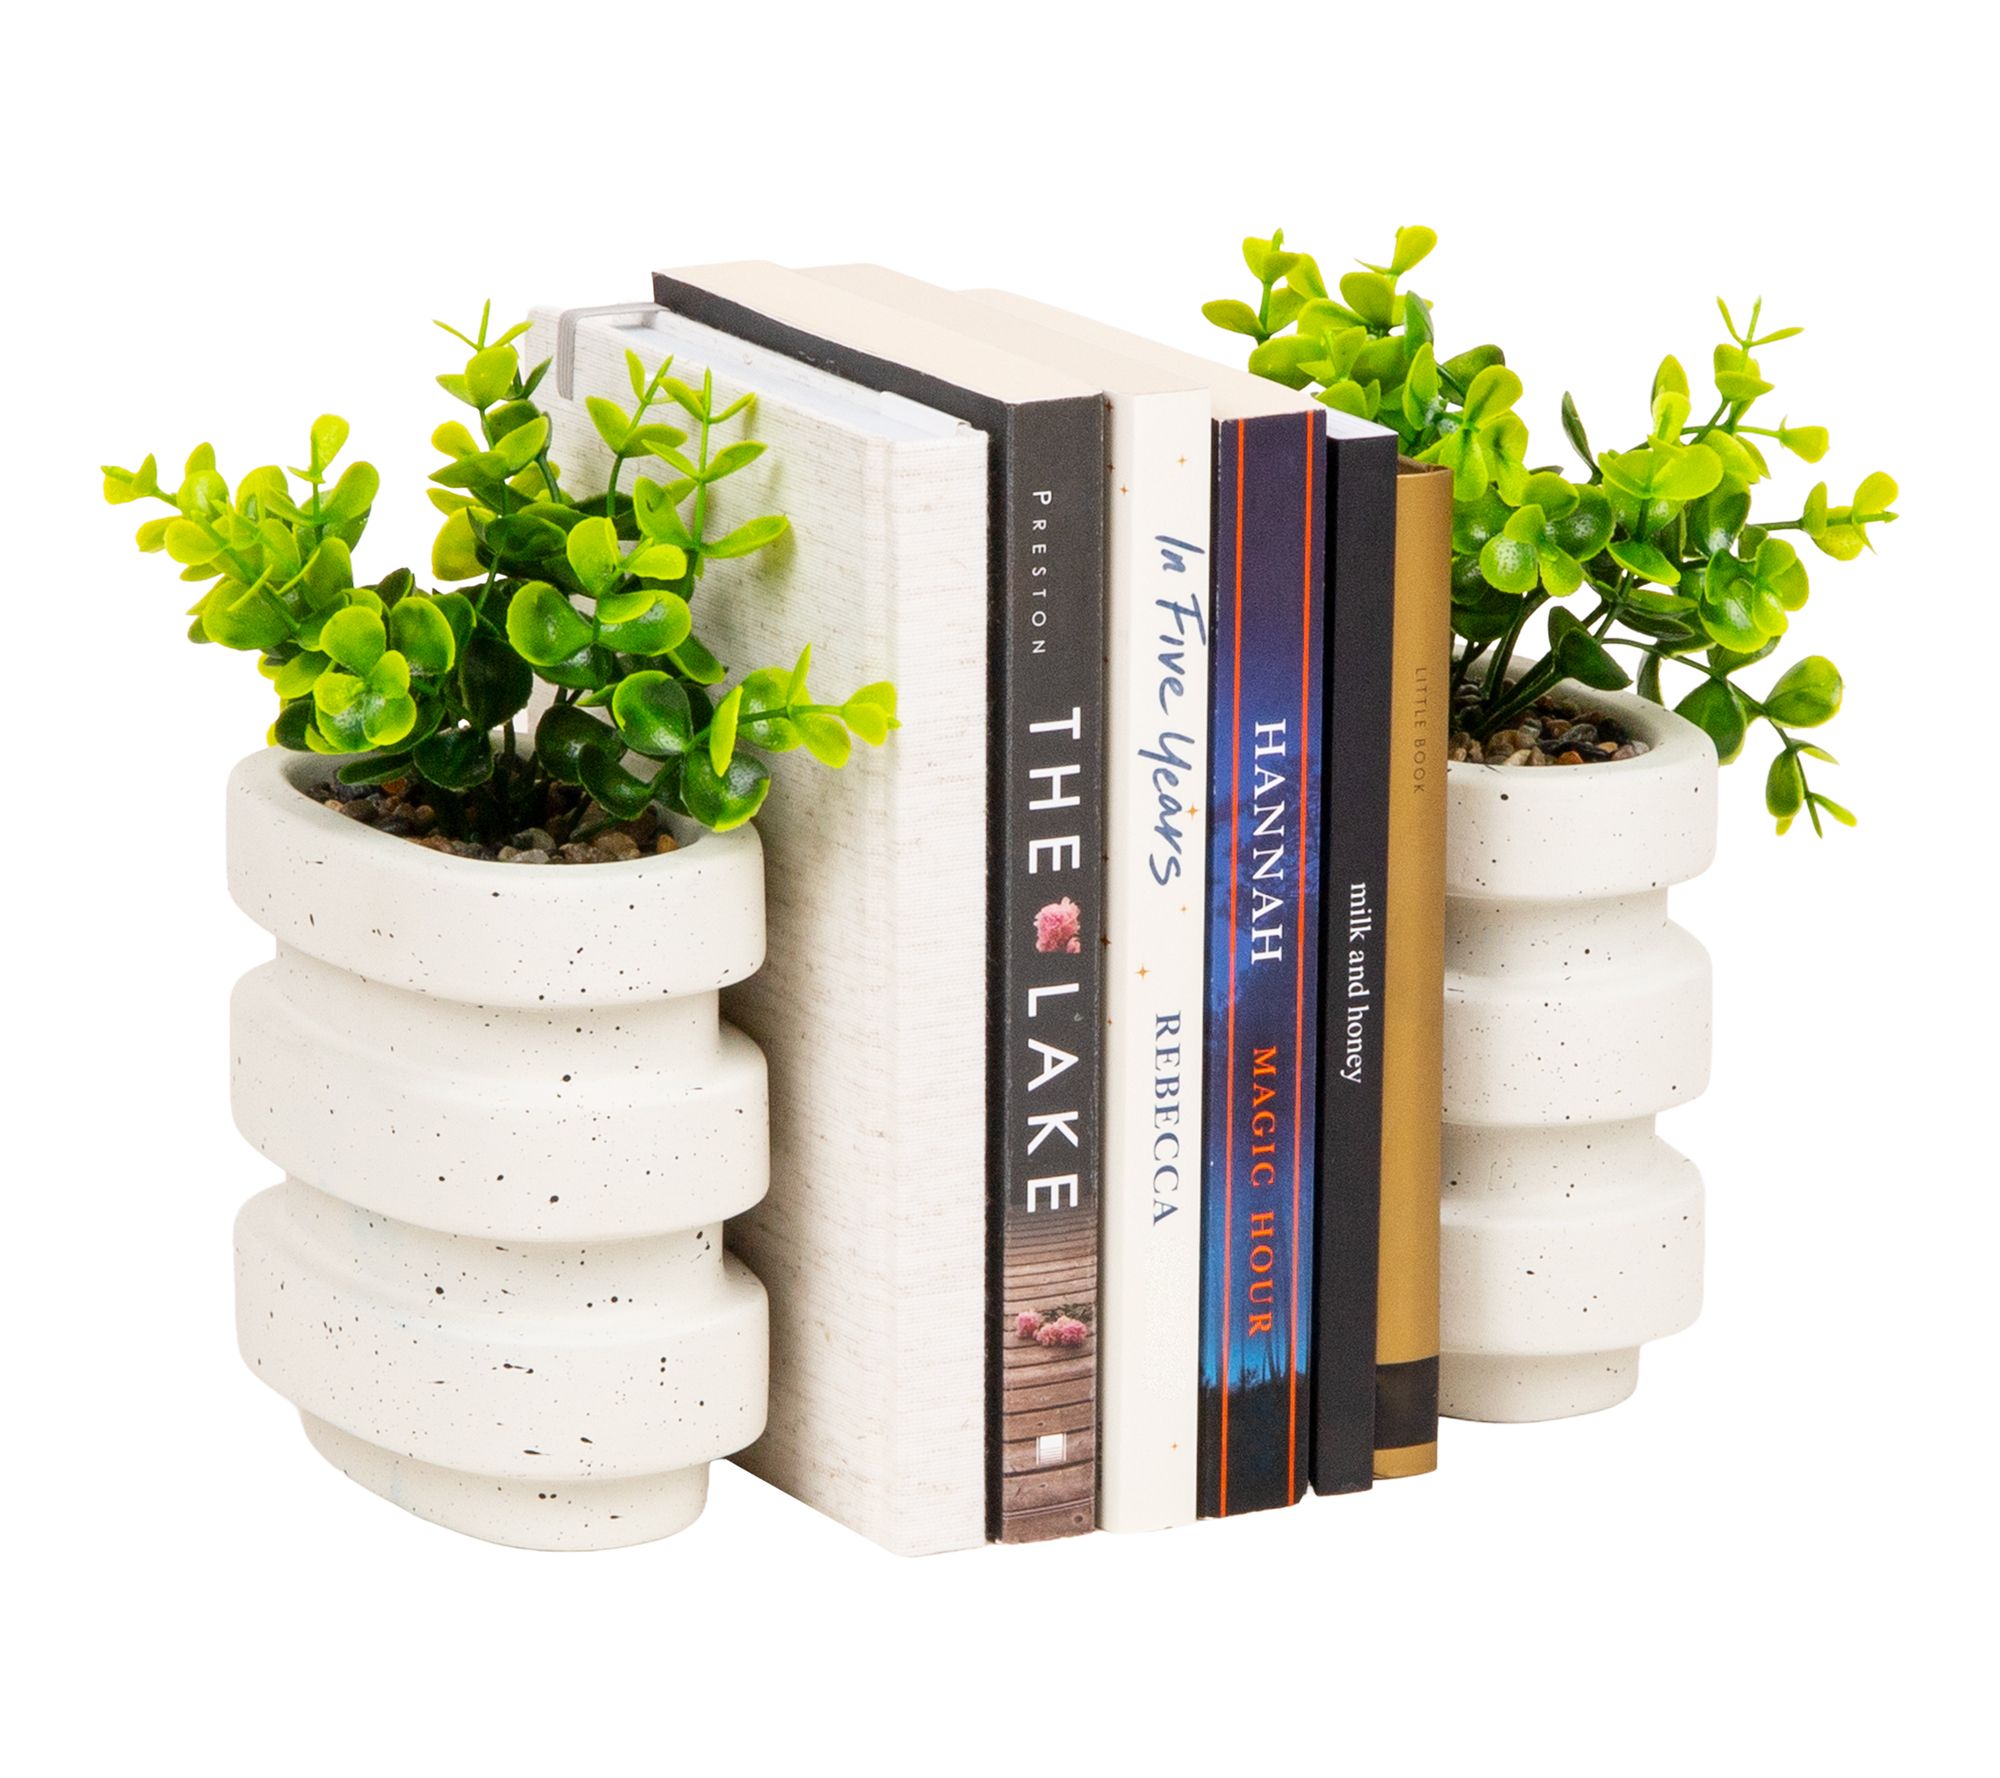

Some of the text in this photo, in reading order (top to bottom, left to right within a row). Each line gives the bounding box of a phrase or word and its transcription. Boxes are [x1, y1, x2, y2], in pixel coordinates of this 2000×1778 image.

[1031, 490, 1052, 654] PRESTON
[1154, 535, 1206, 573] In
[1137, 731, 1196, 886] Years
[1412, 667, 1428, 793] LITTLE BOOK
[1251, 717, 1287, 966] HANNAH
[1026, 706, 1082, 1214] THE LAKE
[1339, 881, 1373, 1084] milk and honey
[1152, 1010, 1182, 1226] REBECCA
[1247, 1045, 1278, 1338] MAGIC HOUR
